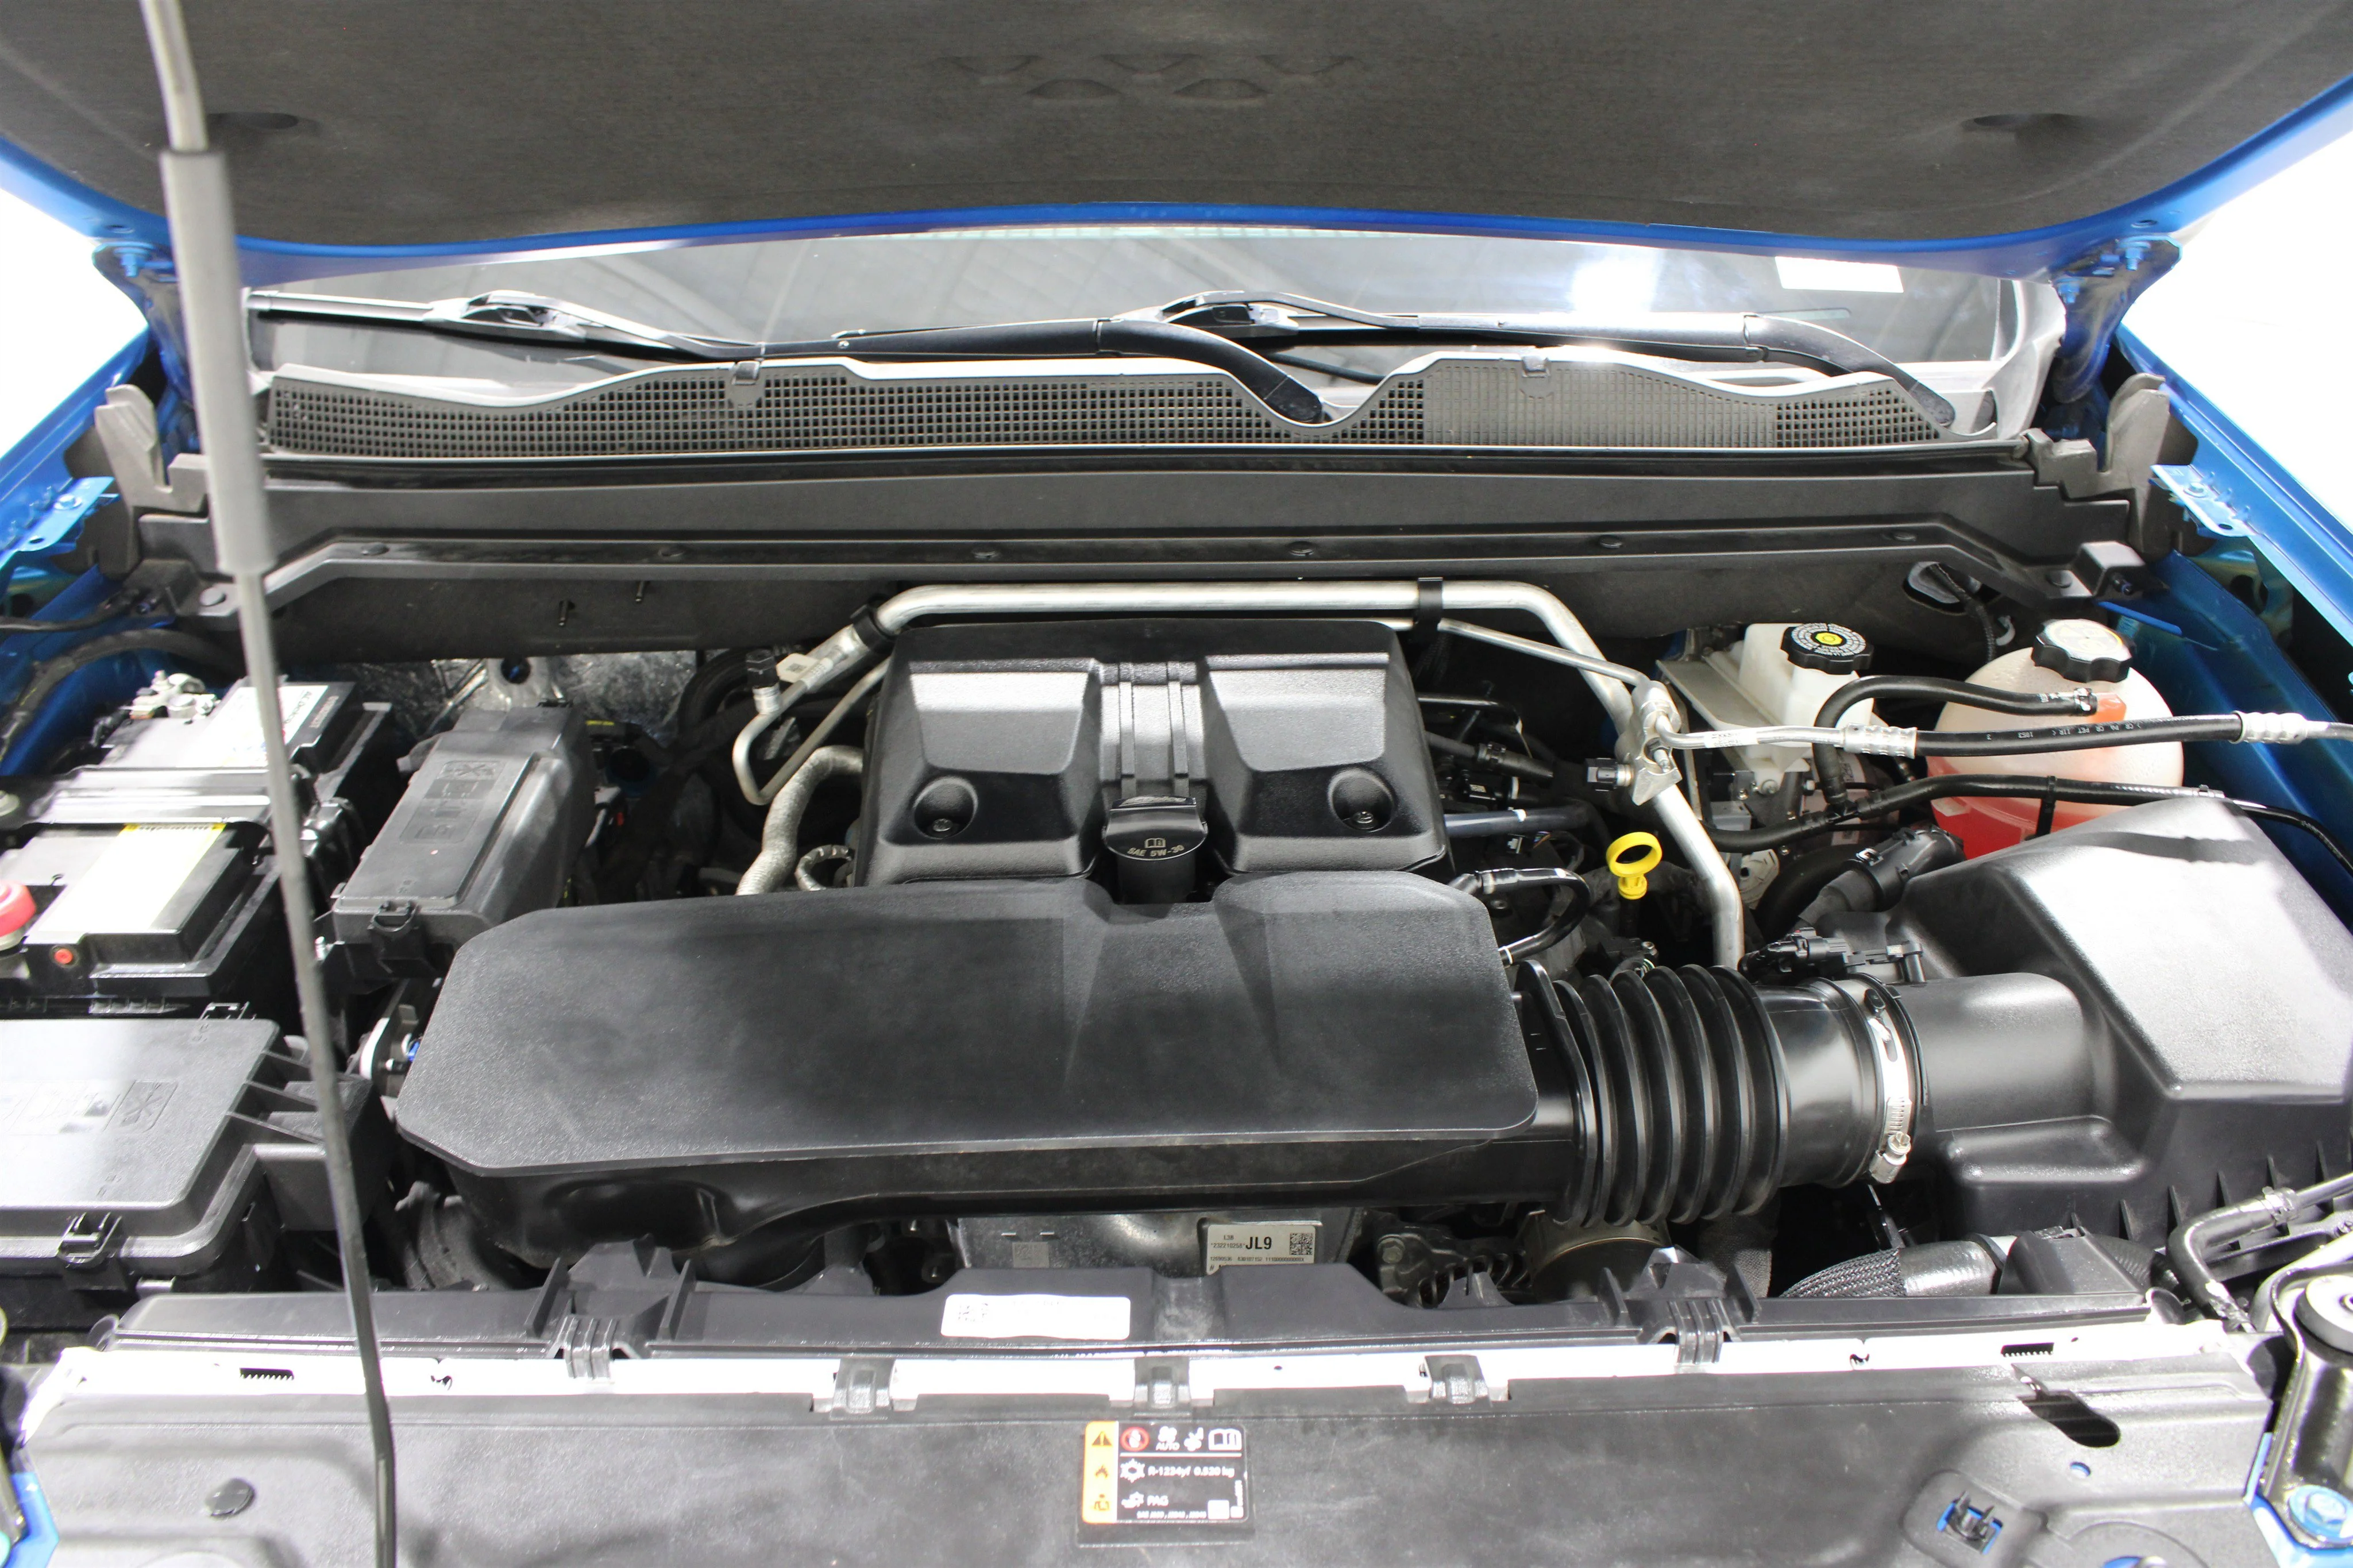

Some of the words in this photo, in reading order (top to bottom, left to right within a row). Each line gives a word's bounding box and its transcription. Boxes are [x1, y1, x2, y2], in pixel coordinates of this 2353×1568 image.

[1127, 847, 1147, 856] SAE
[1150, 845, 1185, 856] 5W-30
[1245, 1236, 1272, 1250] JL9
[1156, 1442, 1180, 1451] AUTO
[1222, 1466, 1235, 1478] kg
[1147, 1495, 1168, 1507] PAG
